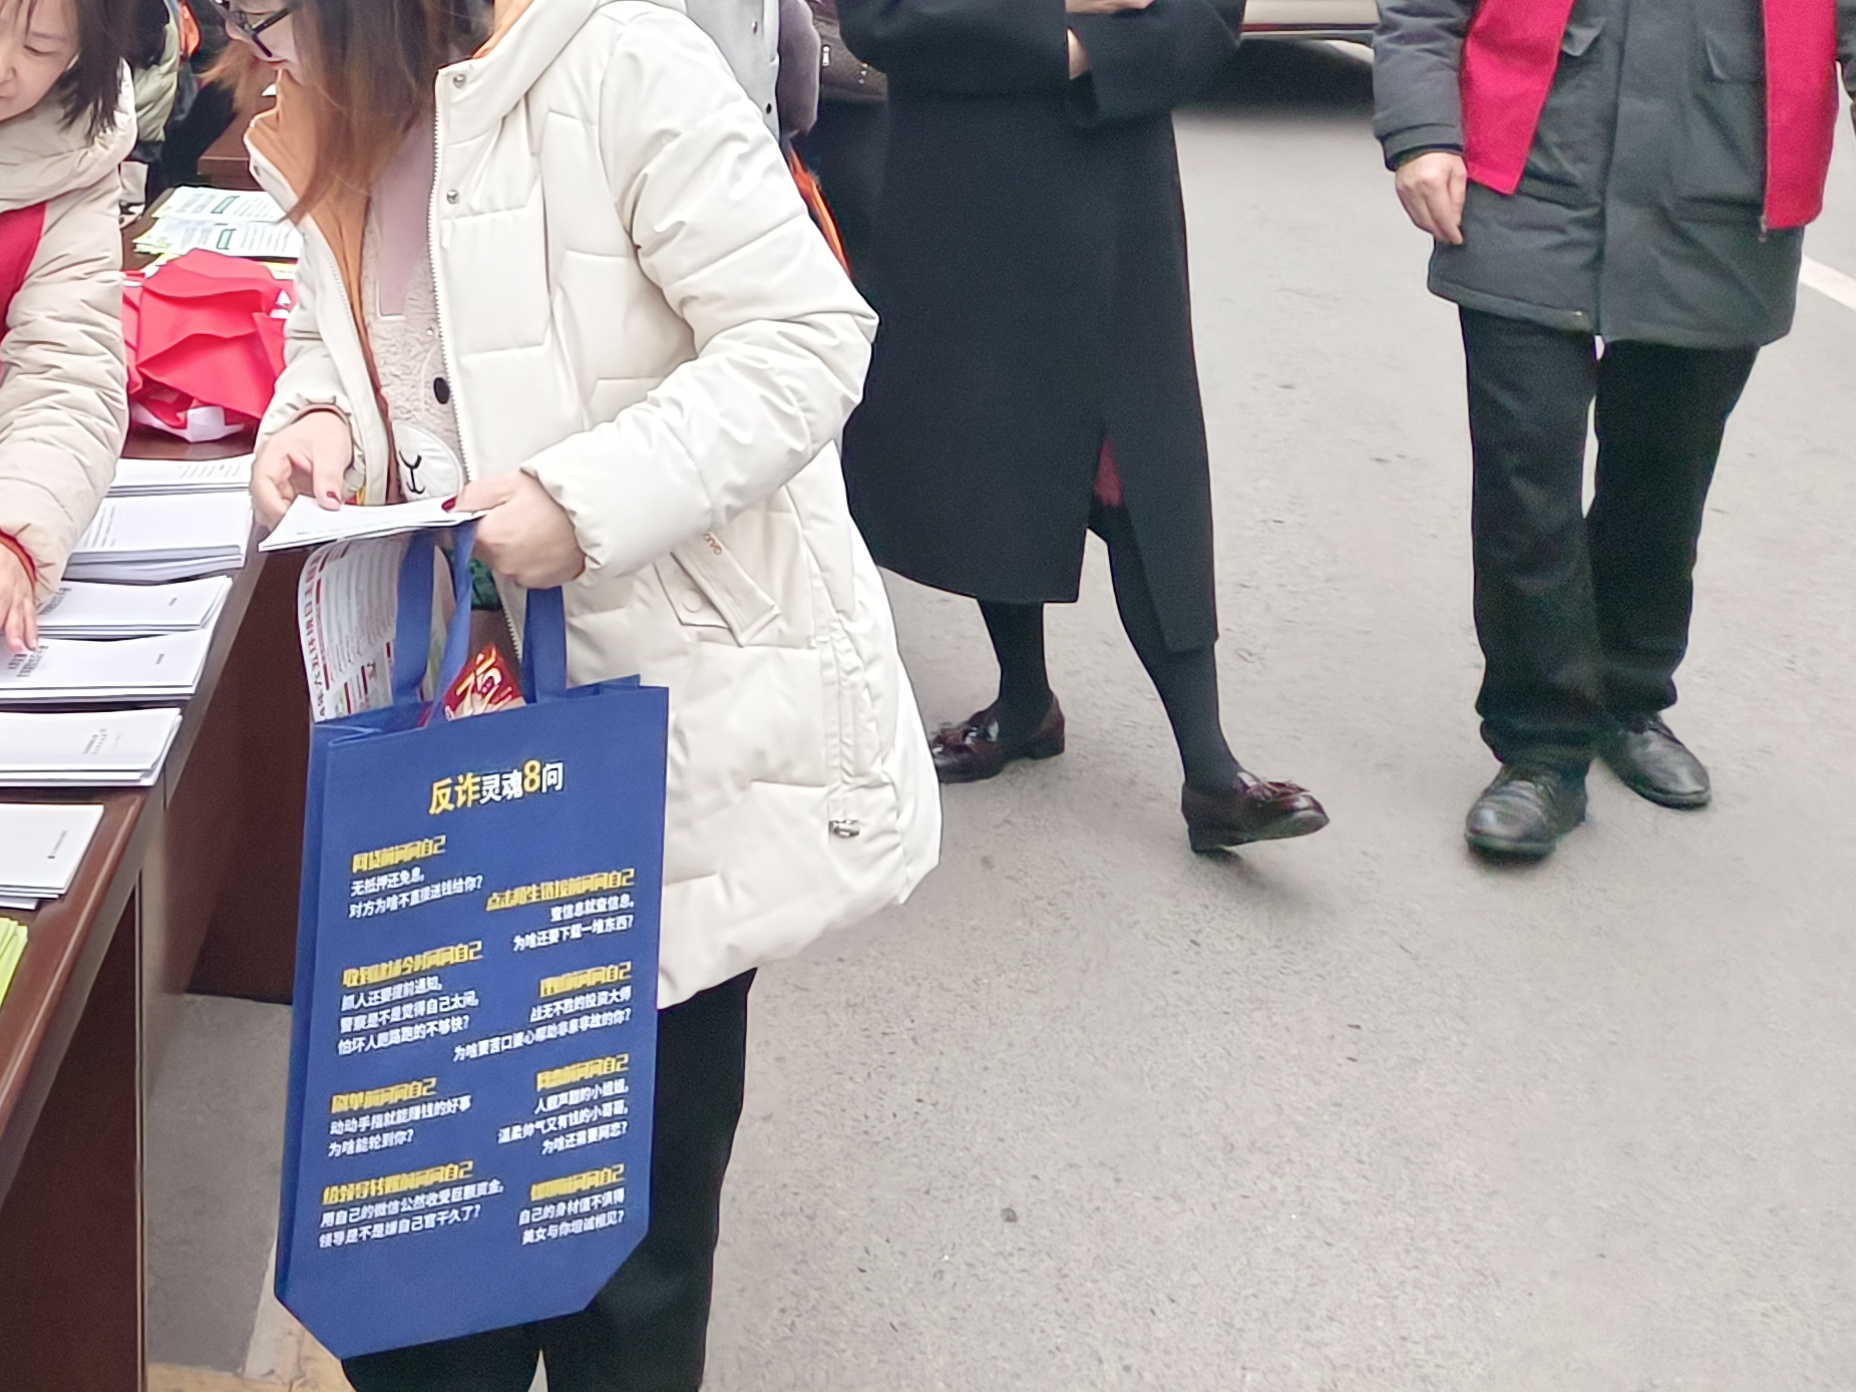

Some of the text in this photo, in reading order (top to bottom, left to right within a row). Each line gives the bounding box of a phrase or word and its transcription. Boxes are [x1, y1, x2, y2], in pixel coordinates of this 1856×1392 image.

[429, 759, 565, 816] 反诈灵魂8问
